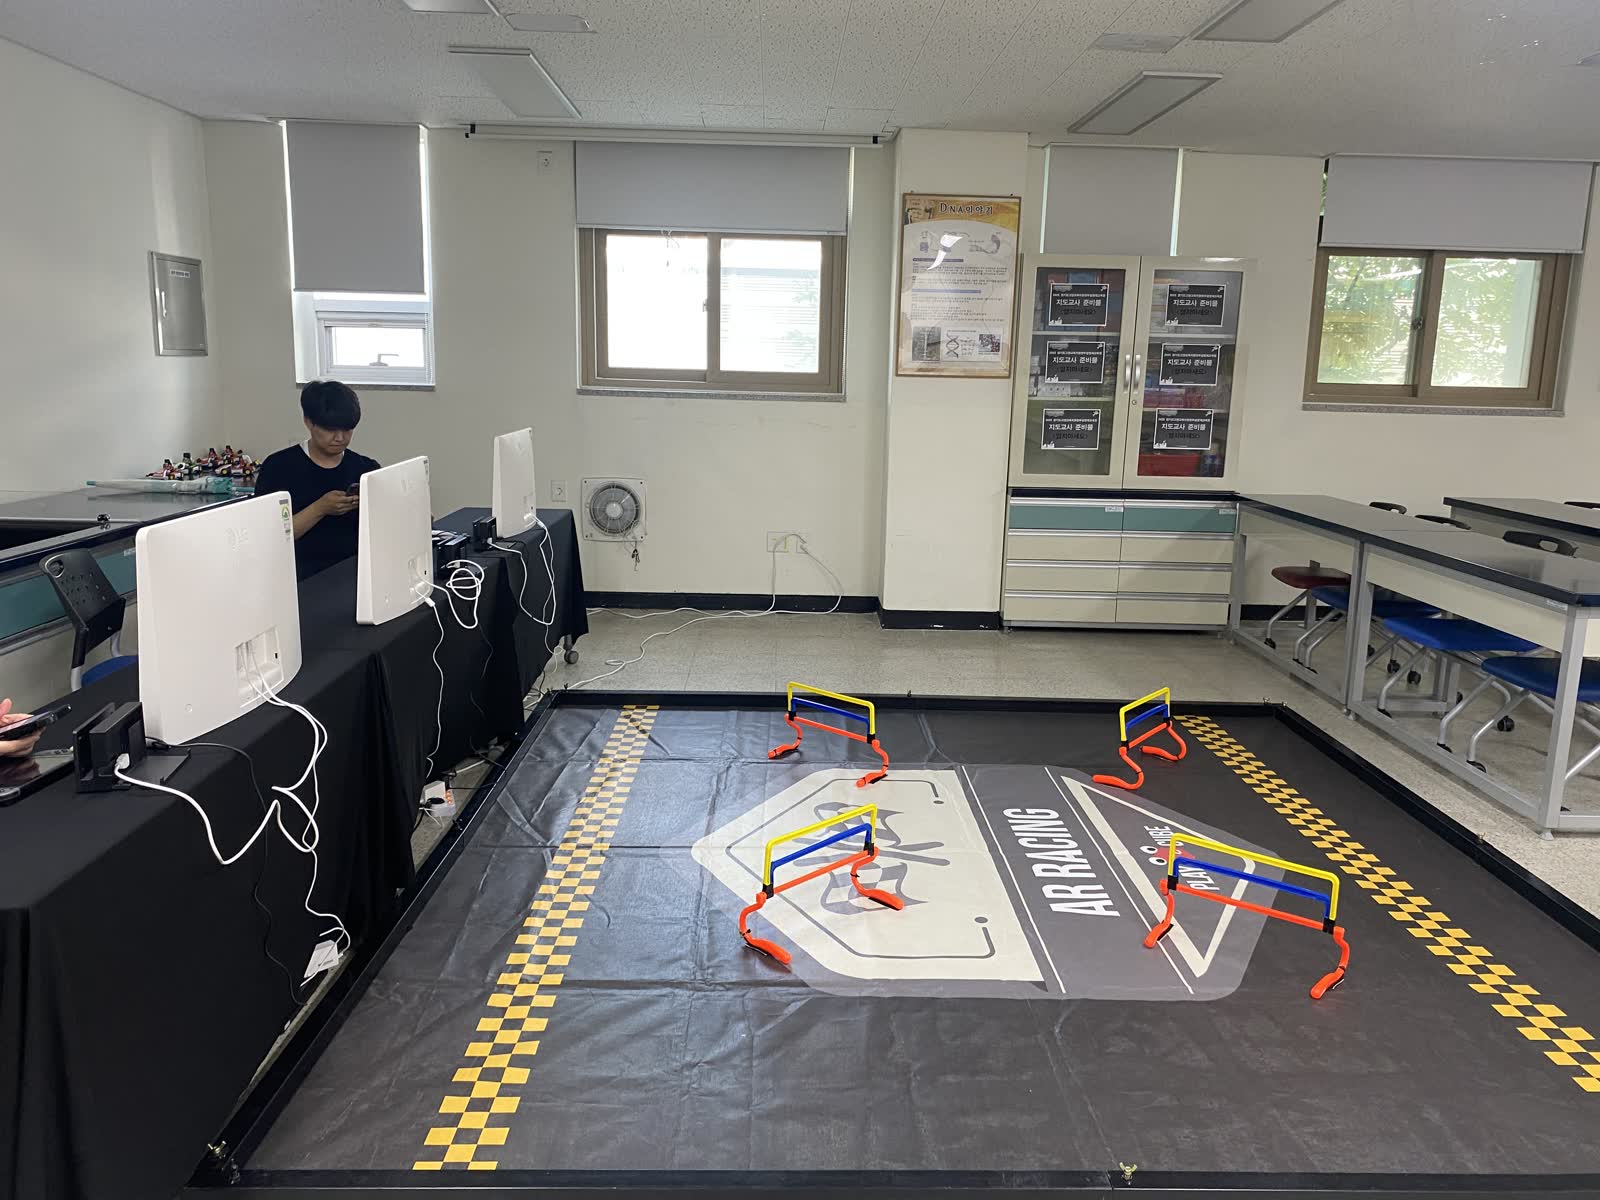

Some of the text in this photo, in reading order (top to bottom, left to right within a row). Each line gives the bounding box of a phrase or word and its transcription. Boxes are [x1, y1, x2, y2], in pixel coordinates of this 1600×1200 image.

[1056, 298, 1080, 306] 지도교사
[1173, 299, 1218, 307] 지도교사 준비물
[1052, 356, 1098, 364] 지도교사 준비물
[1167, 358, 1191, 366] 지도교사
[1048, 423, 1073, 431] 지도교사
[1187, 423, 1206, 431] 준비물
[1003, 808, 1120, 917] AR RACING
[1178, 865, 1220, 891] PLAY
